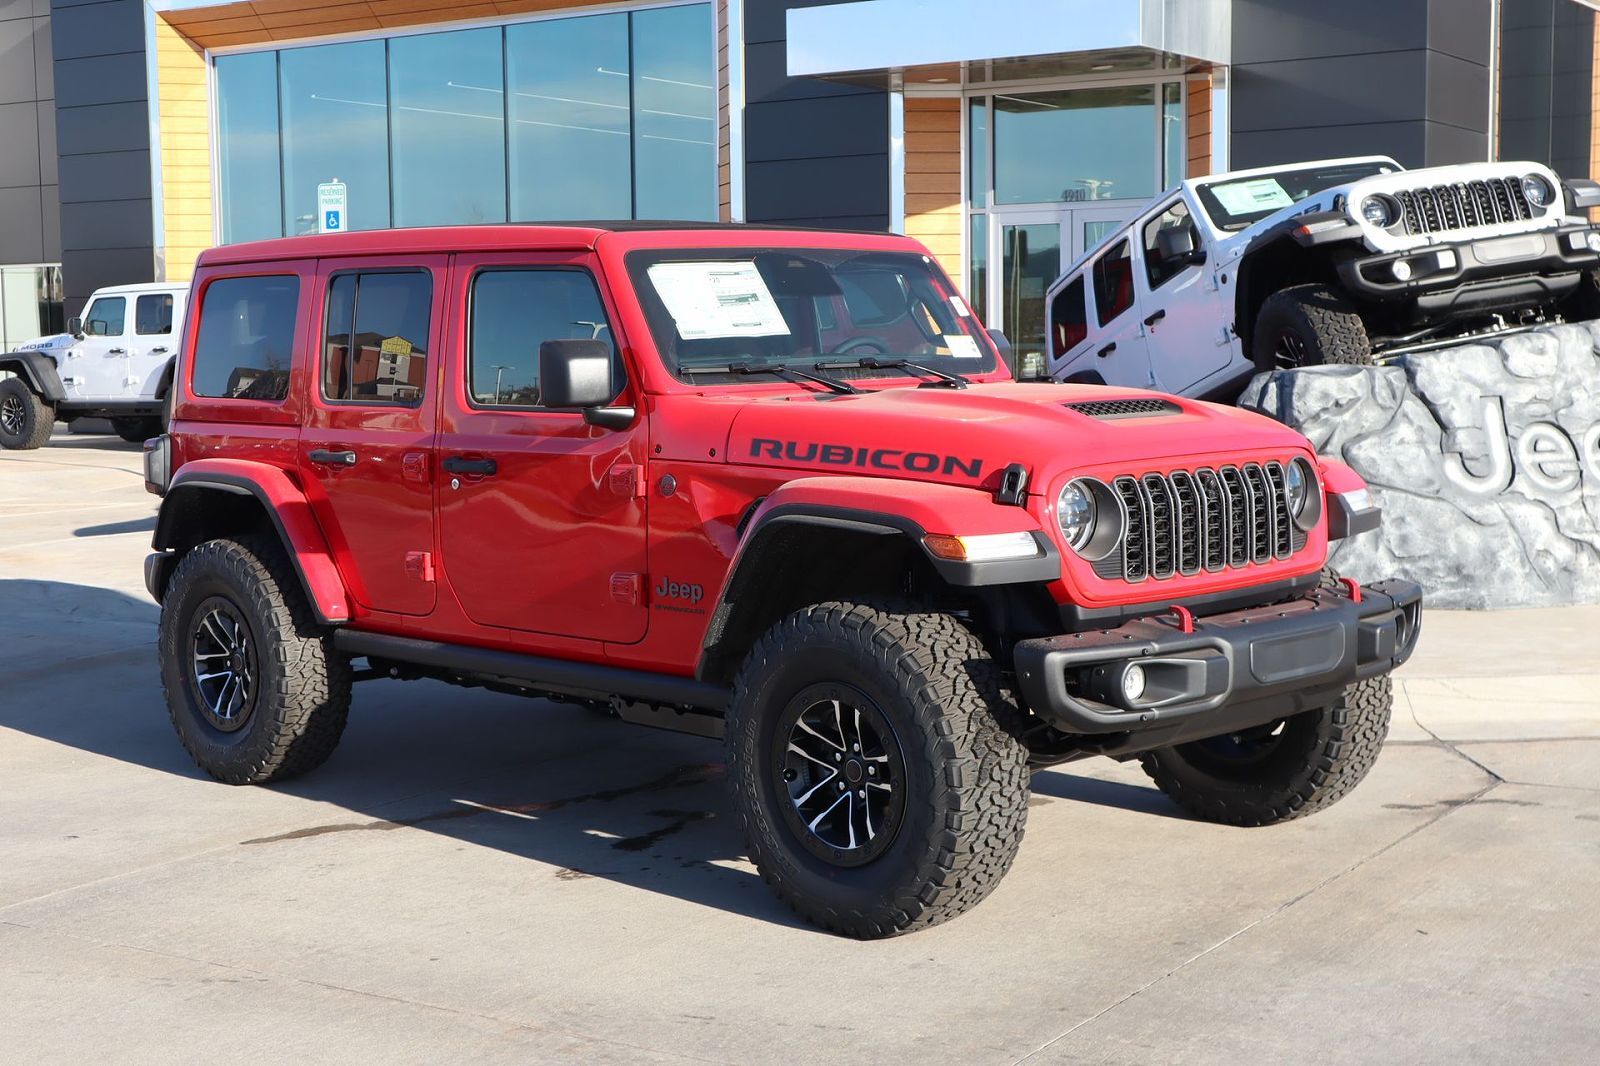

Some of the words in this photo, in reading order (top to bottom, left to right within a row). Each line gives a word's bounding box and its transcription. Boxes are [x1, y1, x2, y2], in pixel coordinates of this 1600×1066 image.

[320, 188, 344, 196] RESERVED
[750, 438, 983, 478] RUBICON
[656, 576, 704, 605] Jeep
